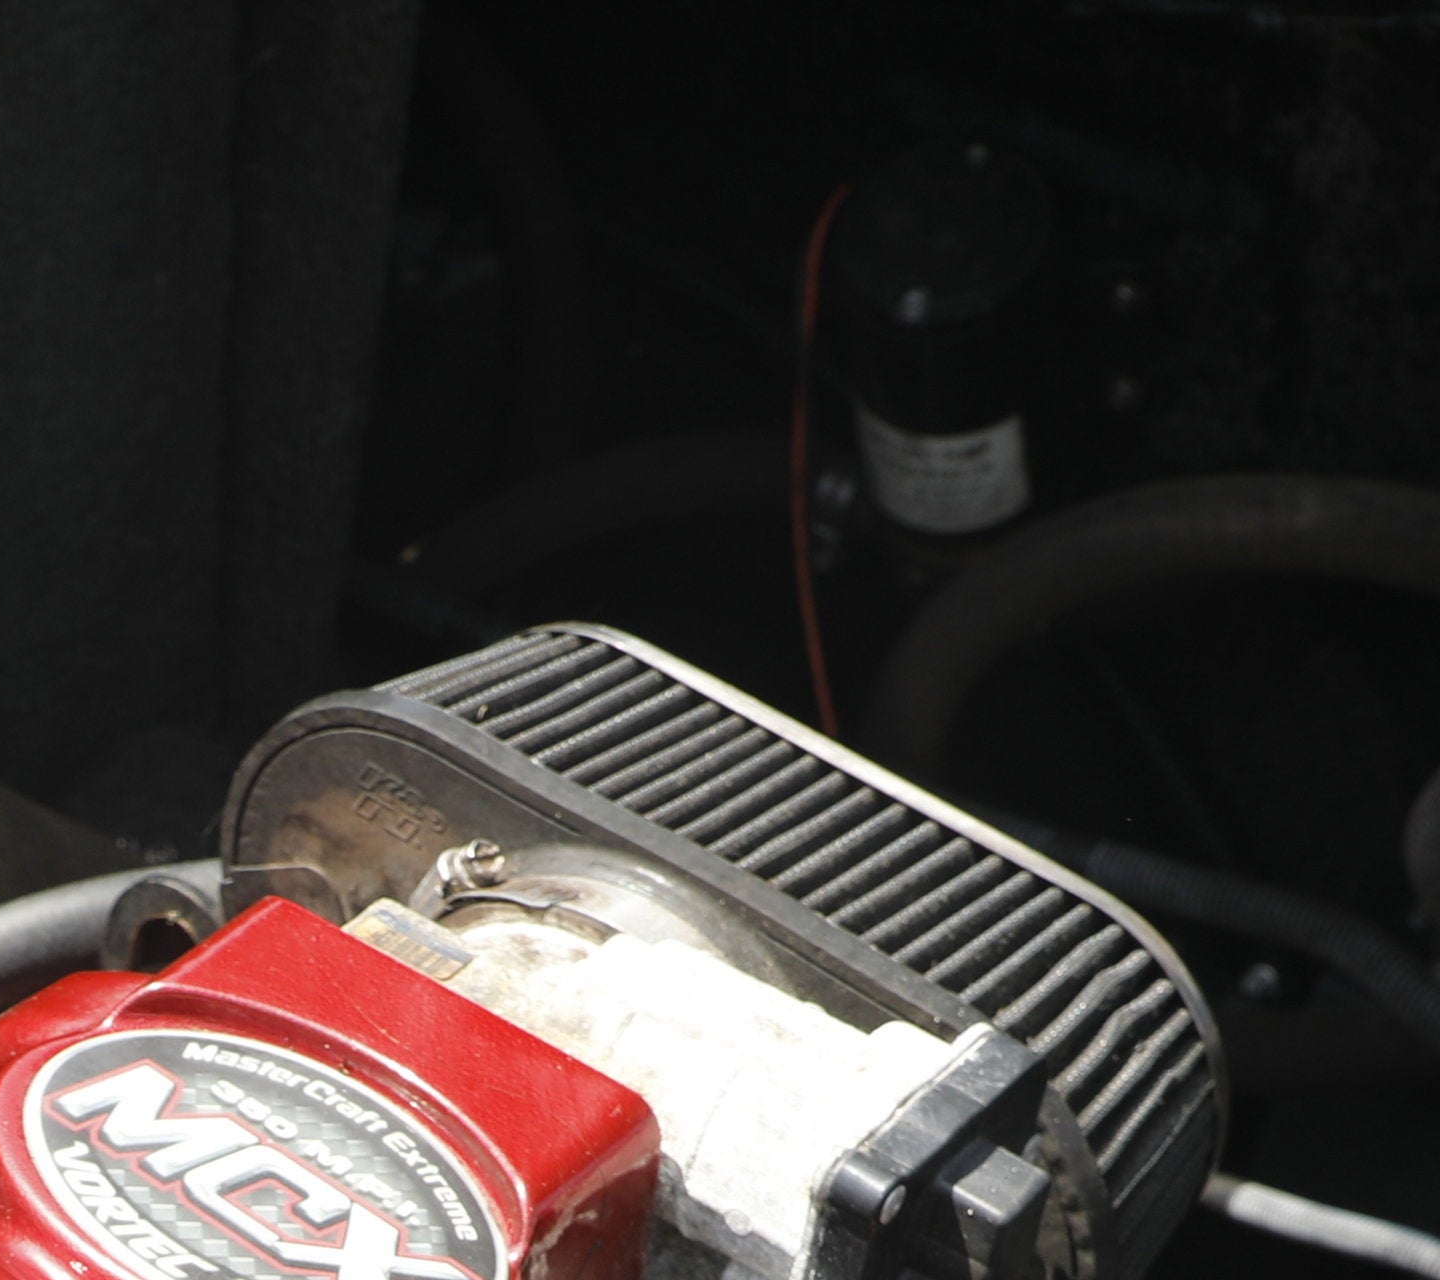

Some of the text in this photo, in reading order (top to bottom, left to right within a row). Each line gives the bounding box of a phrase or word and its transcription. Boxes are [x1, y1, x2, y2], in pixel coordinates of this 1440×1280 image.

[53, 1140, 219, 1279] VORTEC
[181, 1041, 479, 1242] MasterCraft Extreme
